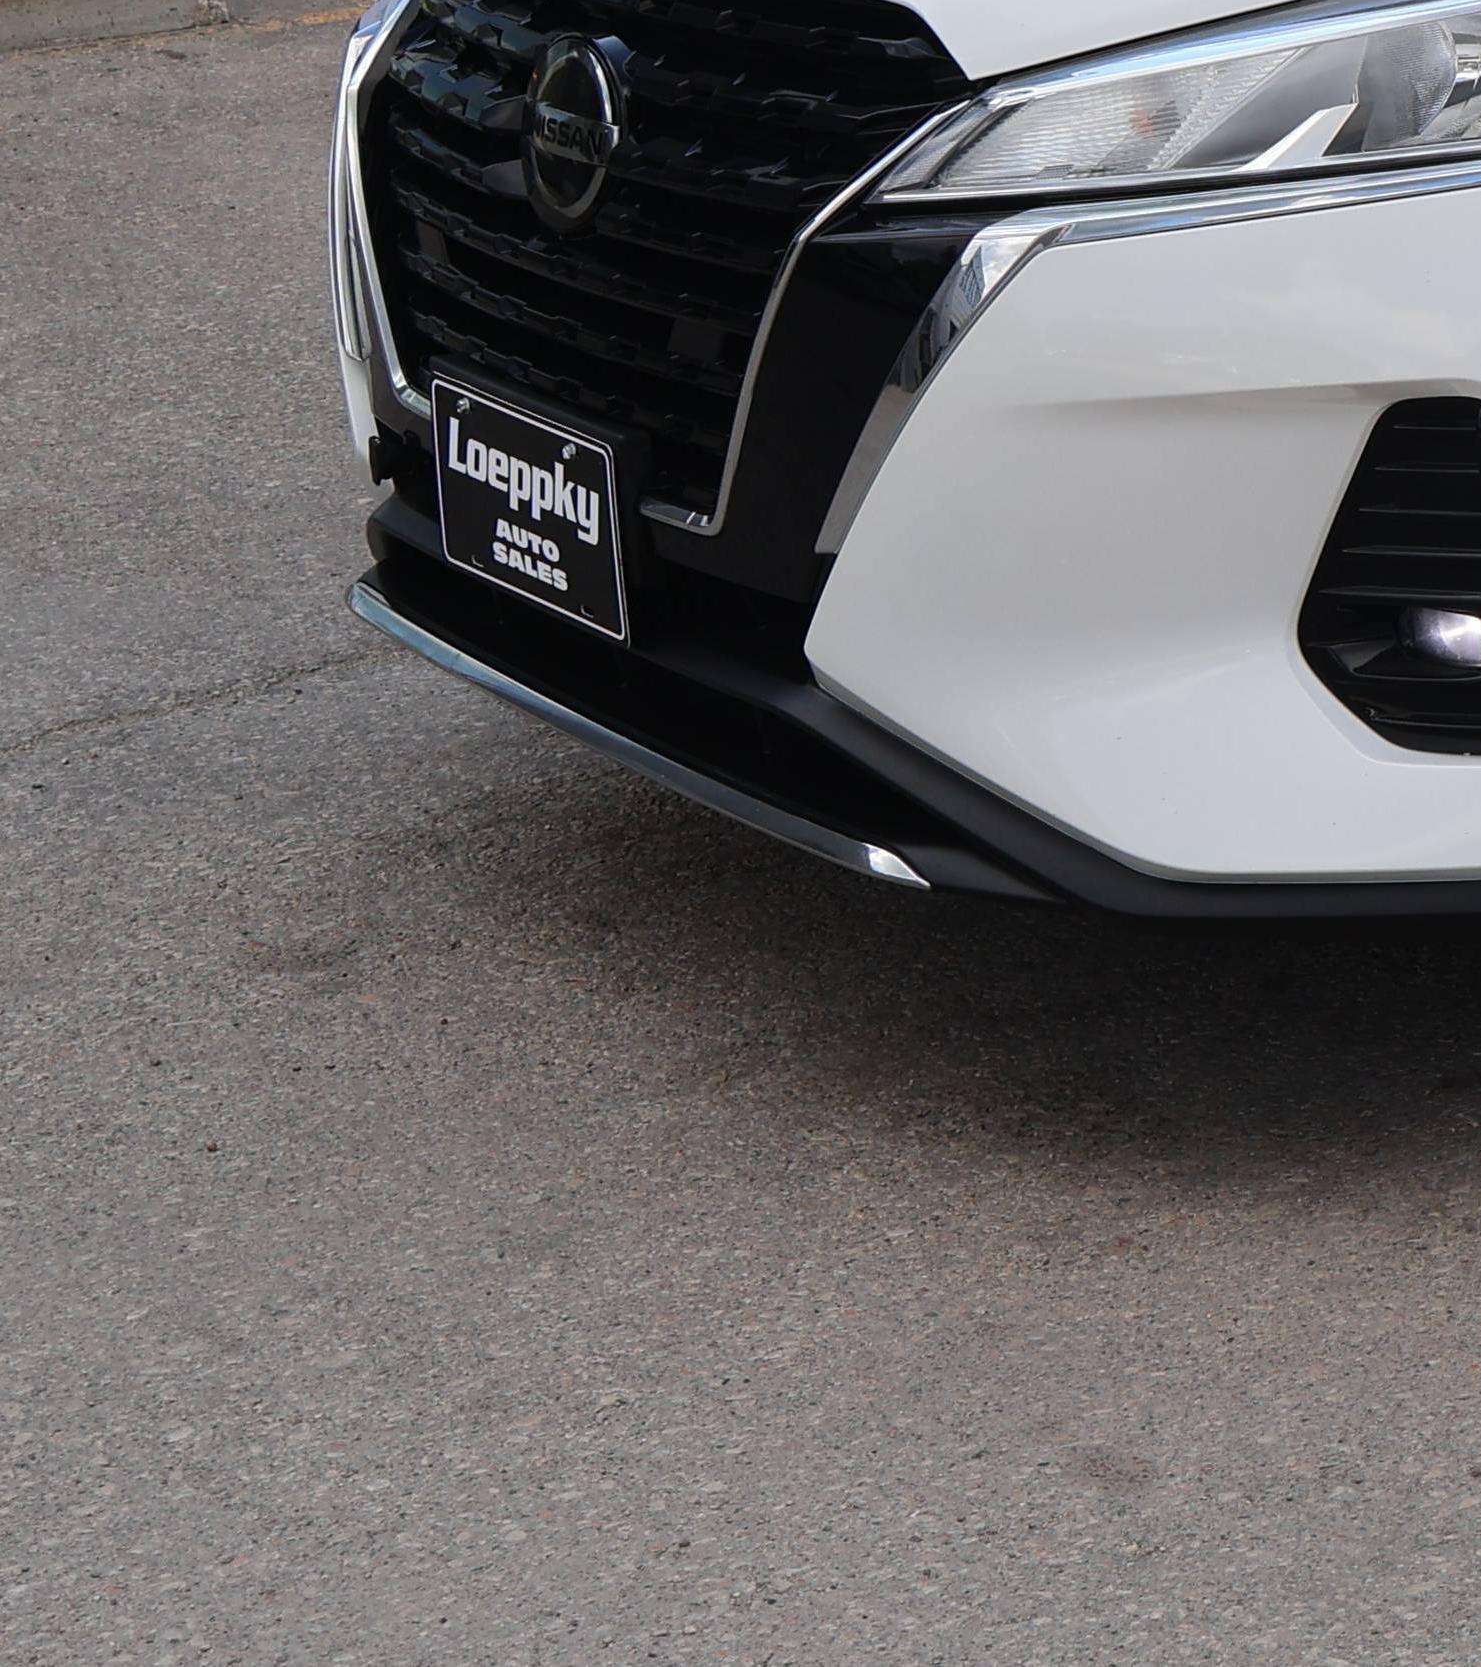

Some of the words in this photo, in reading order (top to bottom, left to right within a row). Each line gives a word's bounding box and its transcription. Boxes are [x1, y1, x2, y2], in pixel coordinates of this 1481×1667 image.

[449, 417, 599, 545] Loeppky
[495, 519, 560, 562] AUTO
[492, 542, 568, 591] SALES
